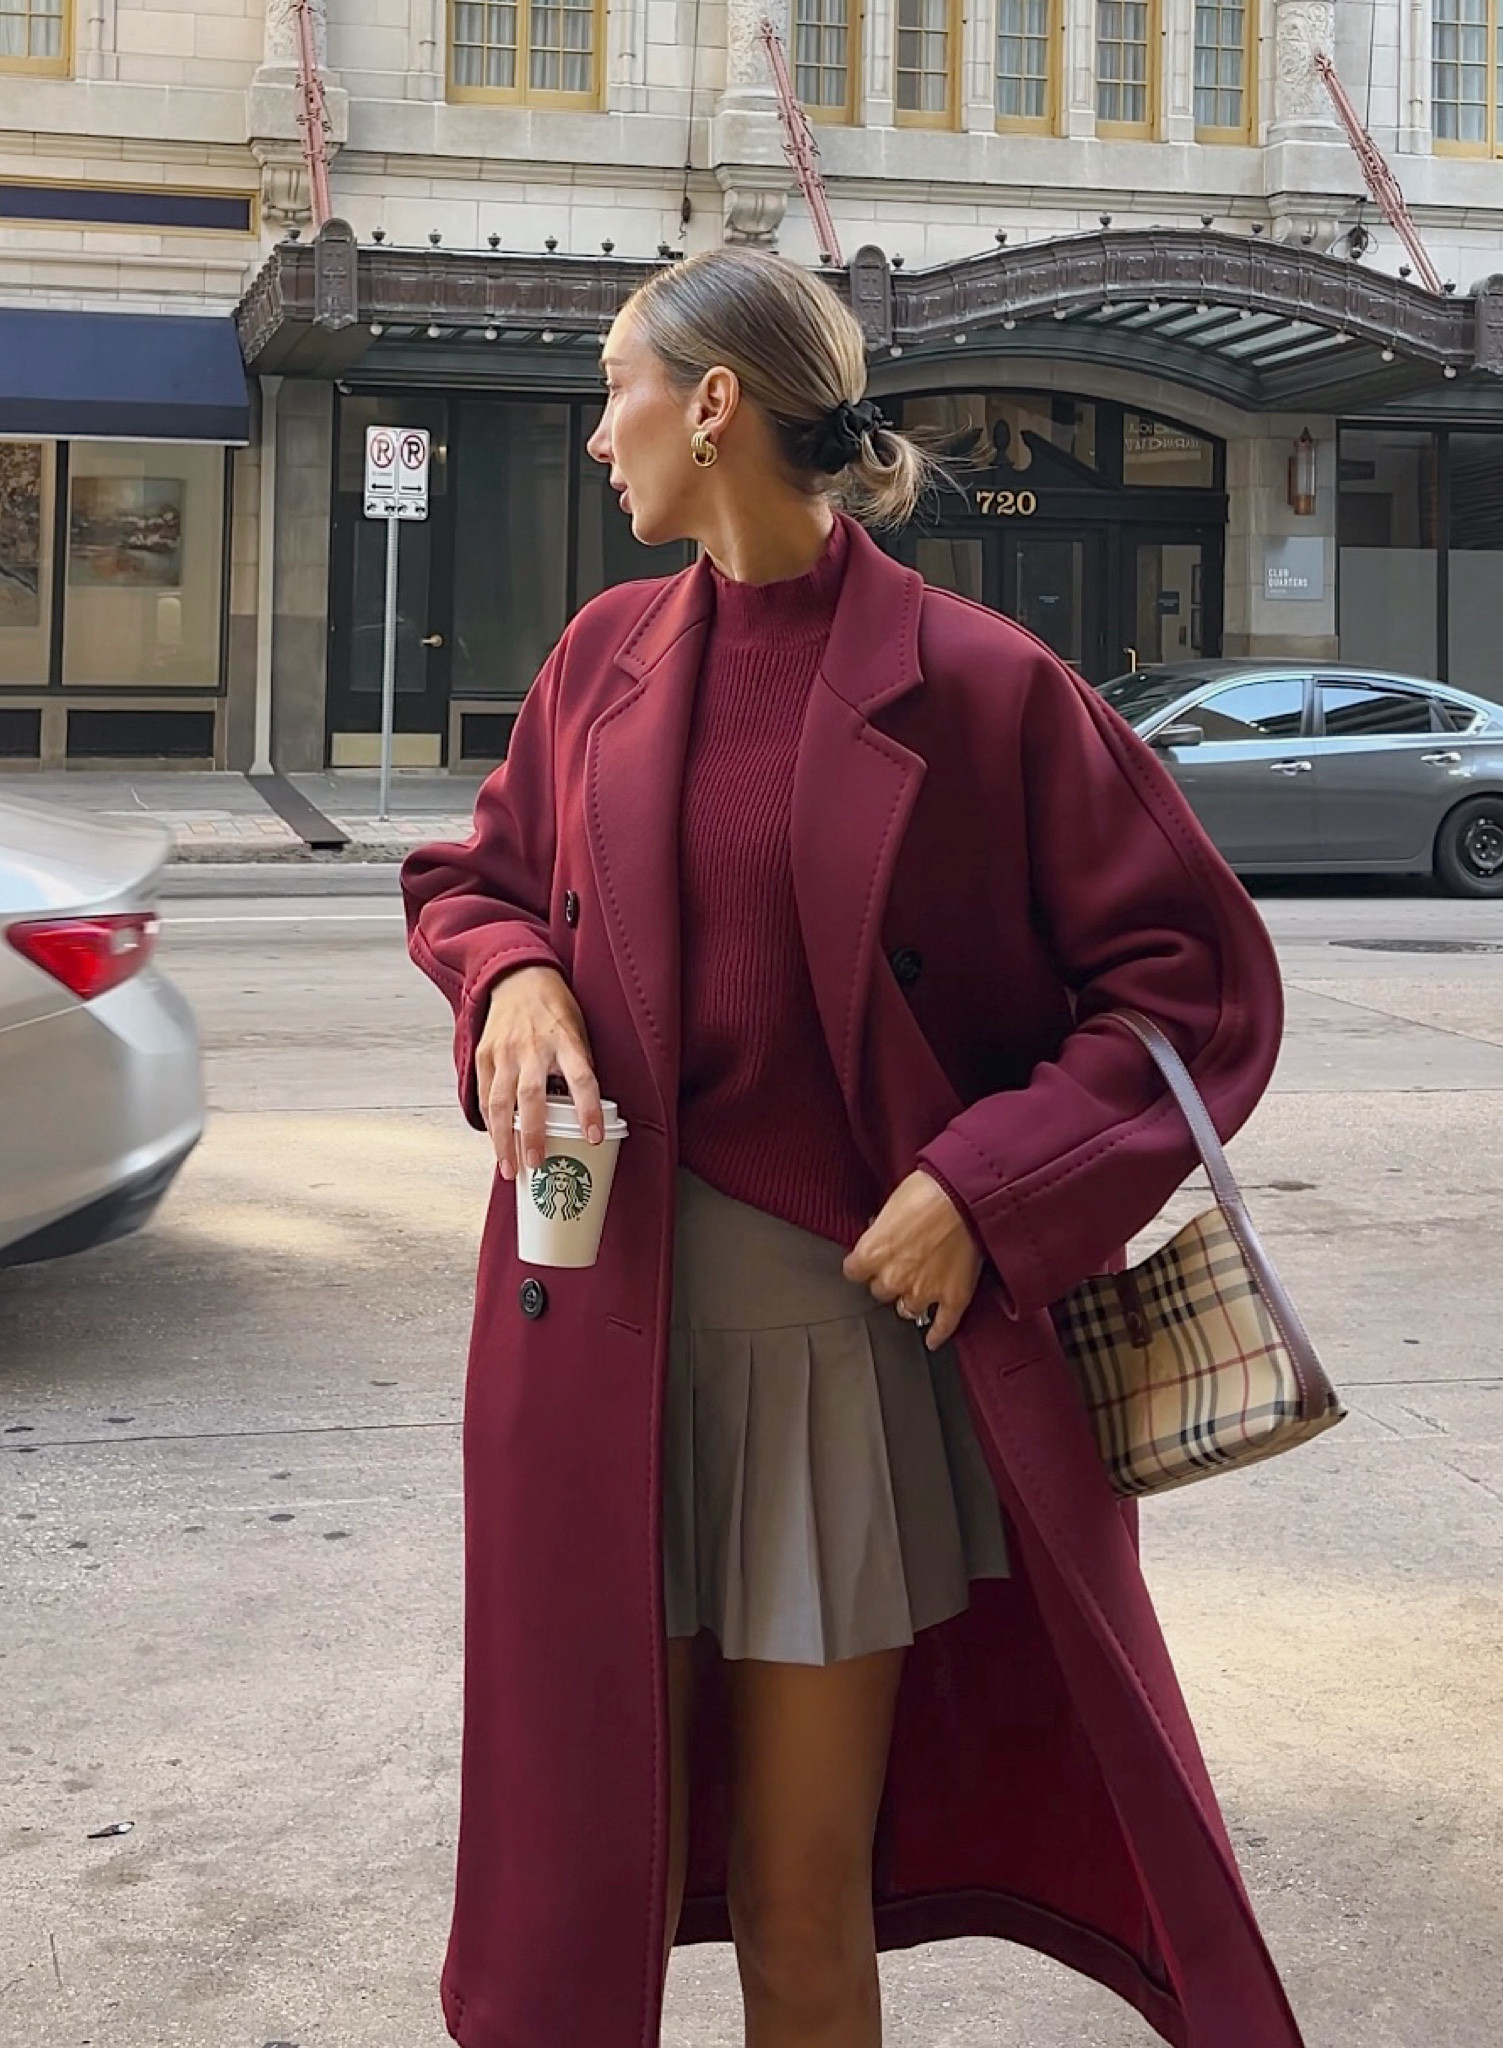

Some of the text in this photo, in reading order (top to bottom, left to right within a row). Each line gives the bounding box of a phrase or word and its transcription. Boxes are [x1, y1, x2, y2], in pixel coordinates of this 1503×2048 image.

[976, 490, 1037, 515] 720
[1268, 568, 1290, 577] CLUB
[1268, 578, 1308, 588] QUARTERS
